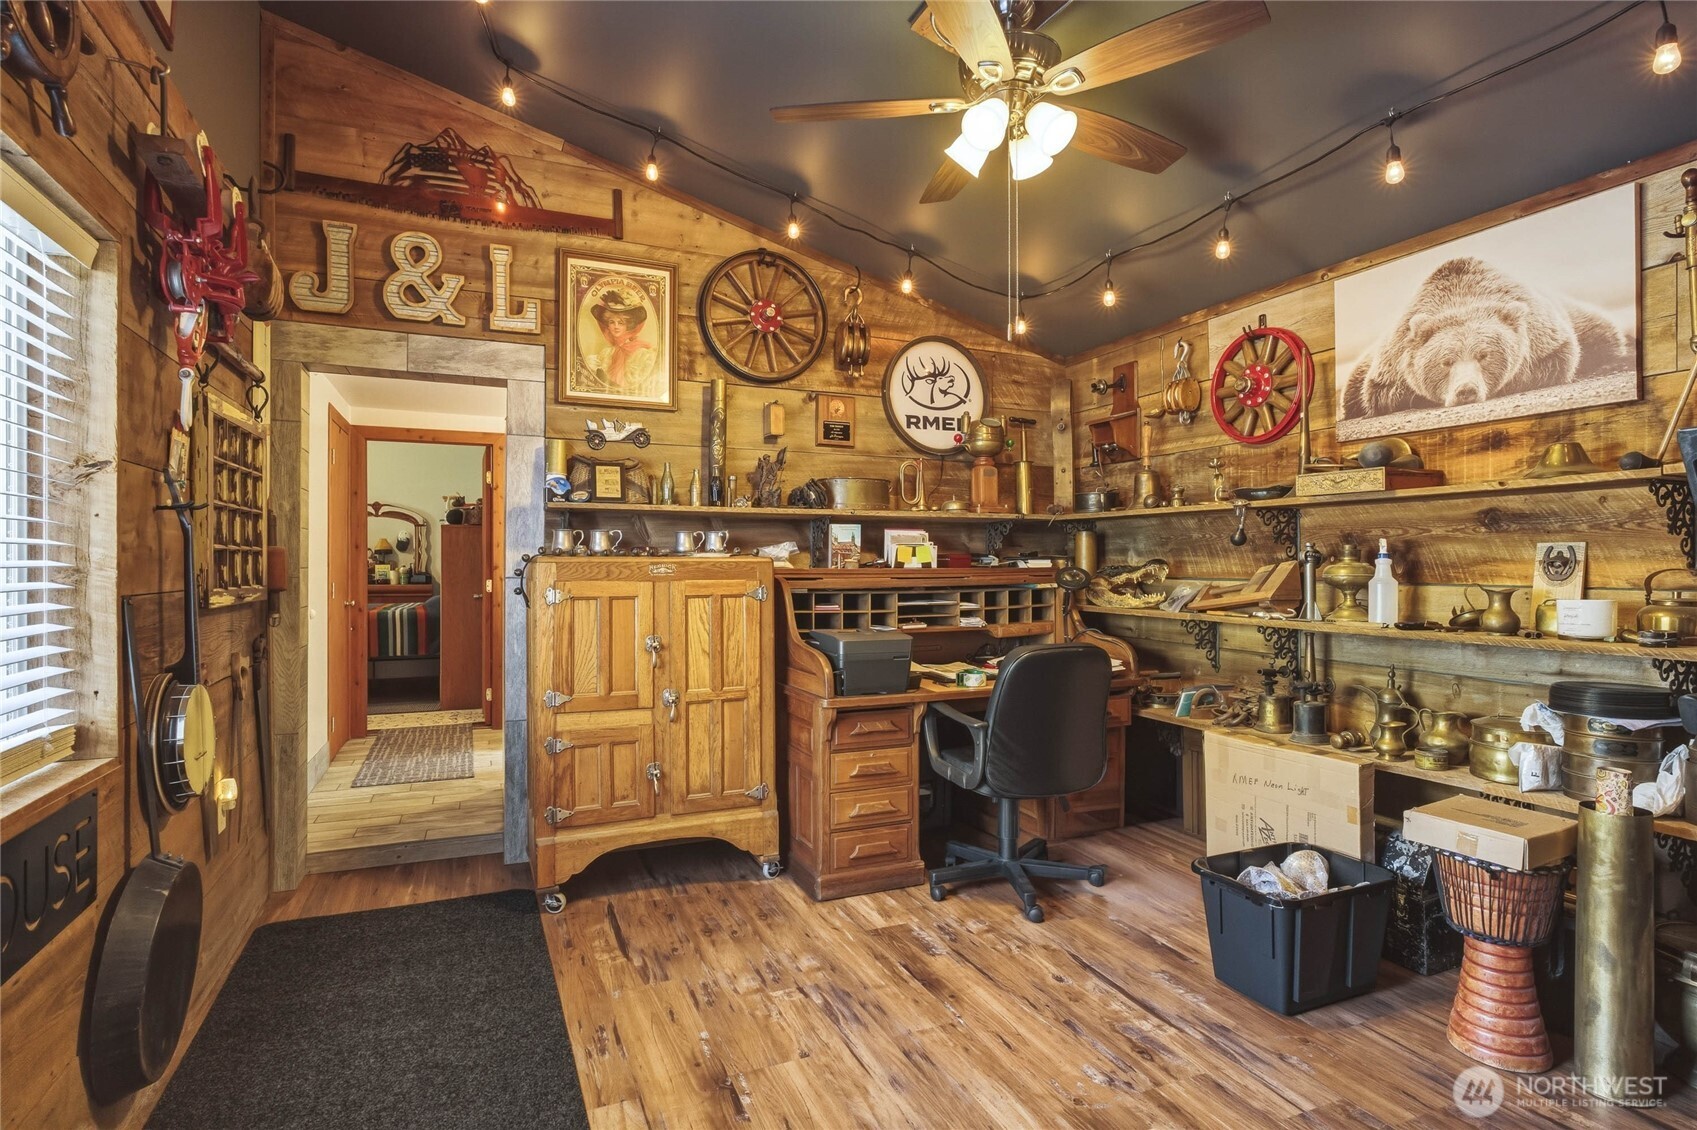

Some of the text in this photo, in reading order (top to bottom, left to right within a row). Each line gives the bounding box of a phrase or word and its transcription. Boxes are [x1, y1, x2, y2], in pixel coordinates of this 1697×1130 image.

[289, 219, 542, 335] J & L
[591, 278, 625, 297] OLYMPIA
[625, 281, 646, 302] BEER
[1263, 780, 1283, 790] Neon
